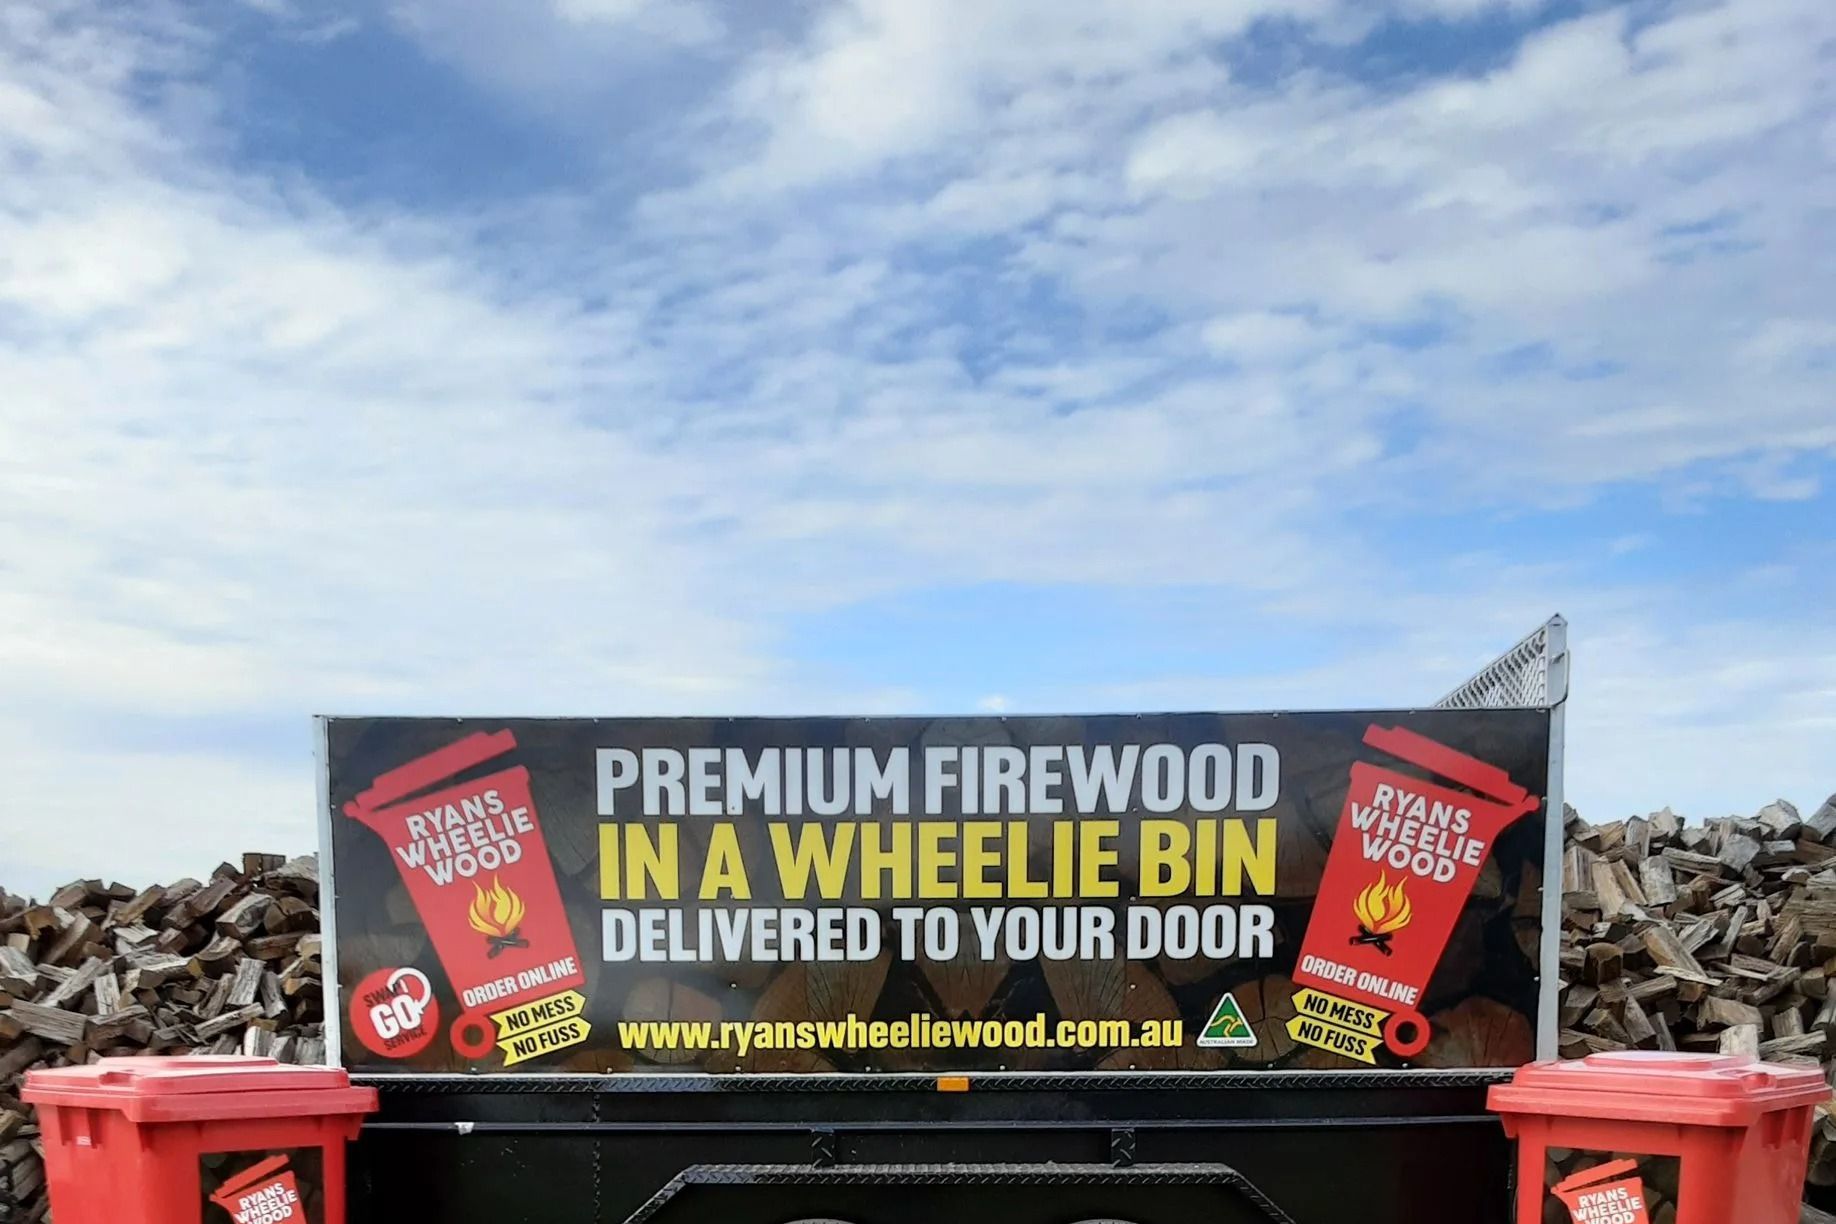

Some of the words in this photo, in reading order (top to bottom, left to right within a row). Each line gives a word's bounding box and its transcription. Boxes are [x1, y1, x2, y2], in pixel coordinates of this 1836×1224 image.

[595, 747, 910, 816] PREMIUM
[924, 743, 1280, 815] FIREWOOD
[405, 790, 504, 841] RYANS
[1372, 783, 1472, 835] RYANS
[396, 807, 534, 869] WHEELIE
[1350, 802, 1485, 867] WHEELIE
[424, 840, 522, 887] WOOD
[598, 822, 679, 900] IN
[698, 822, 752, 900] A
[767, 820, 1120, 900] WHEELIE
[1139, 818, 1277, 898] BIN
[1362, 833, 1456, 884] WOOD
[601, 907, 881, 962] DELIVERED
[892, 907, 959, 962] TO
[970, 906, 1116, 961] YOUR
[1127, 904, 1275, 960] DOOR
[462, 974, 521, 1008] ORDER
[519, 956, 577, 991] ONLINE
[1301, 954, 1356, 987] ORDER
[1357, 971, 1418, 1006] ONLINE
[369, 994, 421, 1039] GO
[506, 1006, 532, 1031] NO
[534, 996, 576, 1023] MESS
[617, 1013, 1183, 1057] www.ryanswheeliewood.com.au
[1303, 994, 1328, 1016] NO
[1330, 1003, 1375, 1029] MESS
[513, 1034, 538, 1058] NO
[540, 1023, 581, 1050] FUSS
[1298, 1021, 1323, 1043] NO
[1324, 1030, 1368, 1056] FUSS
[234, 1190, 298, 1224] WHEELIE
[238, 1182, 285, 1210] RYANS
[1572, 1197, 1642, 1222] WHEELIE
[1578, 1187, 1628, 1209] RYANS
